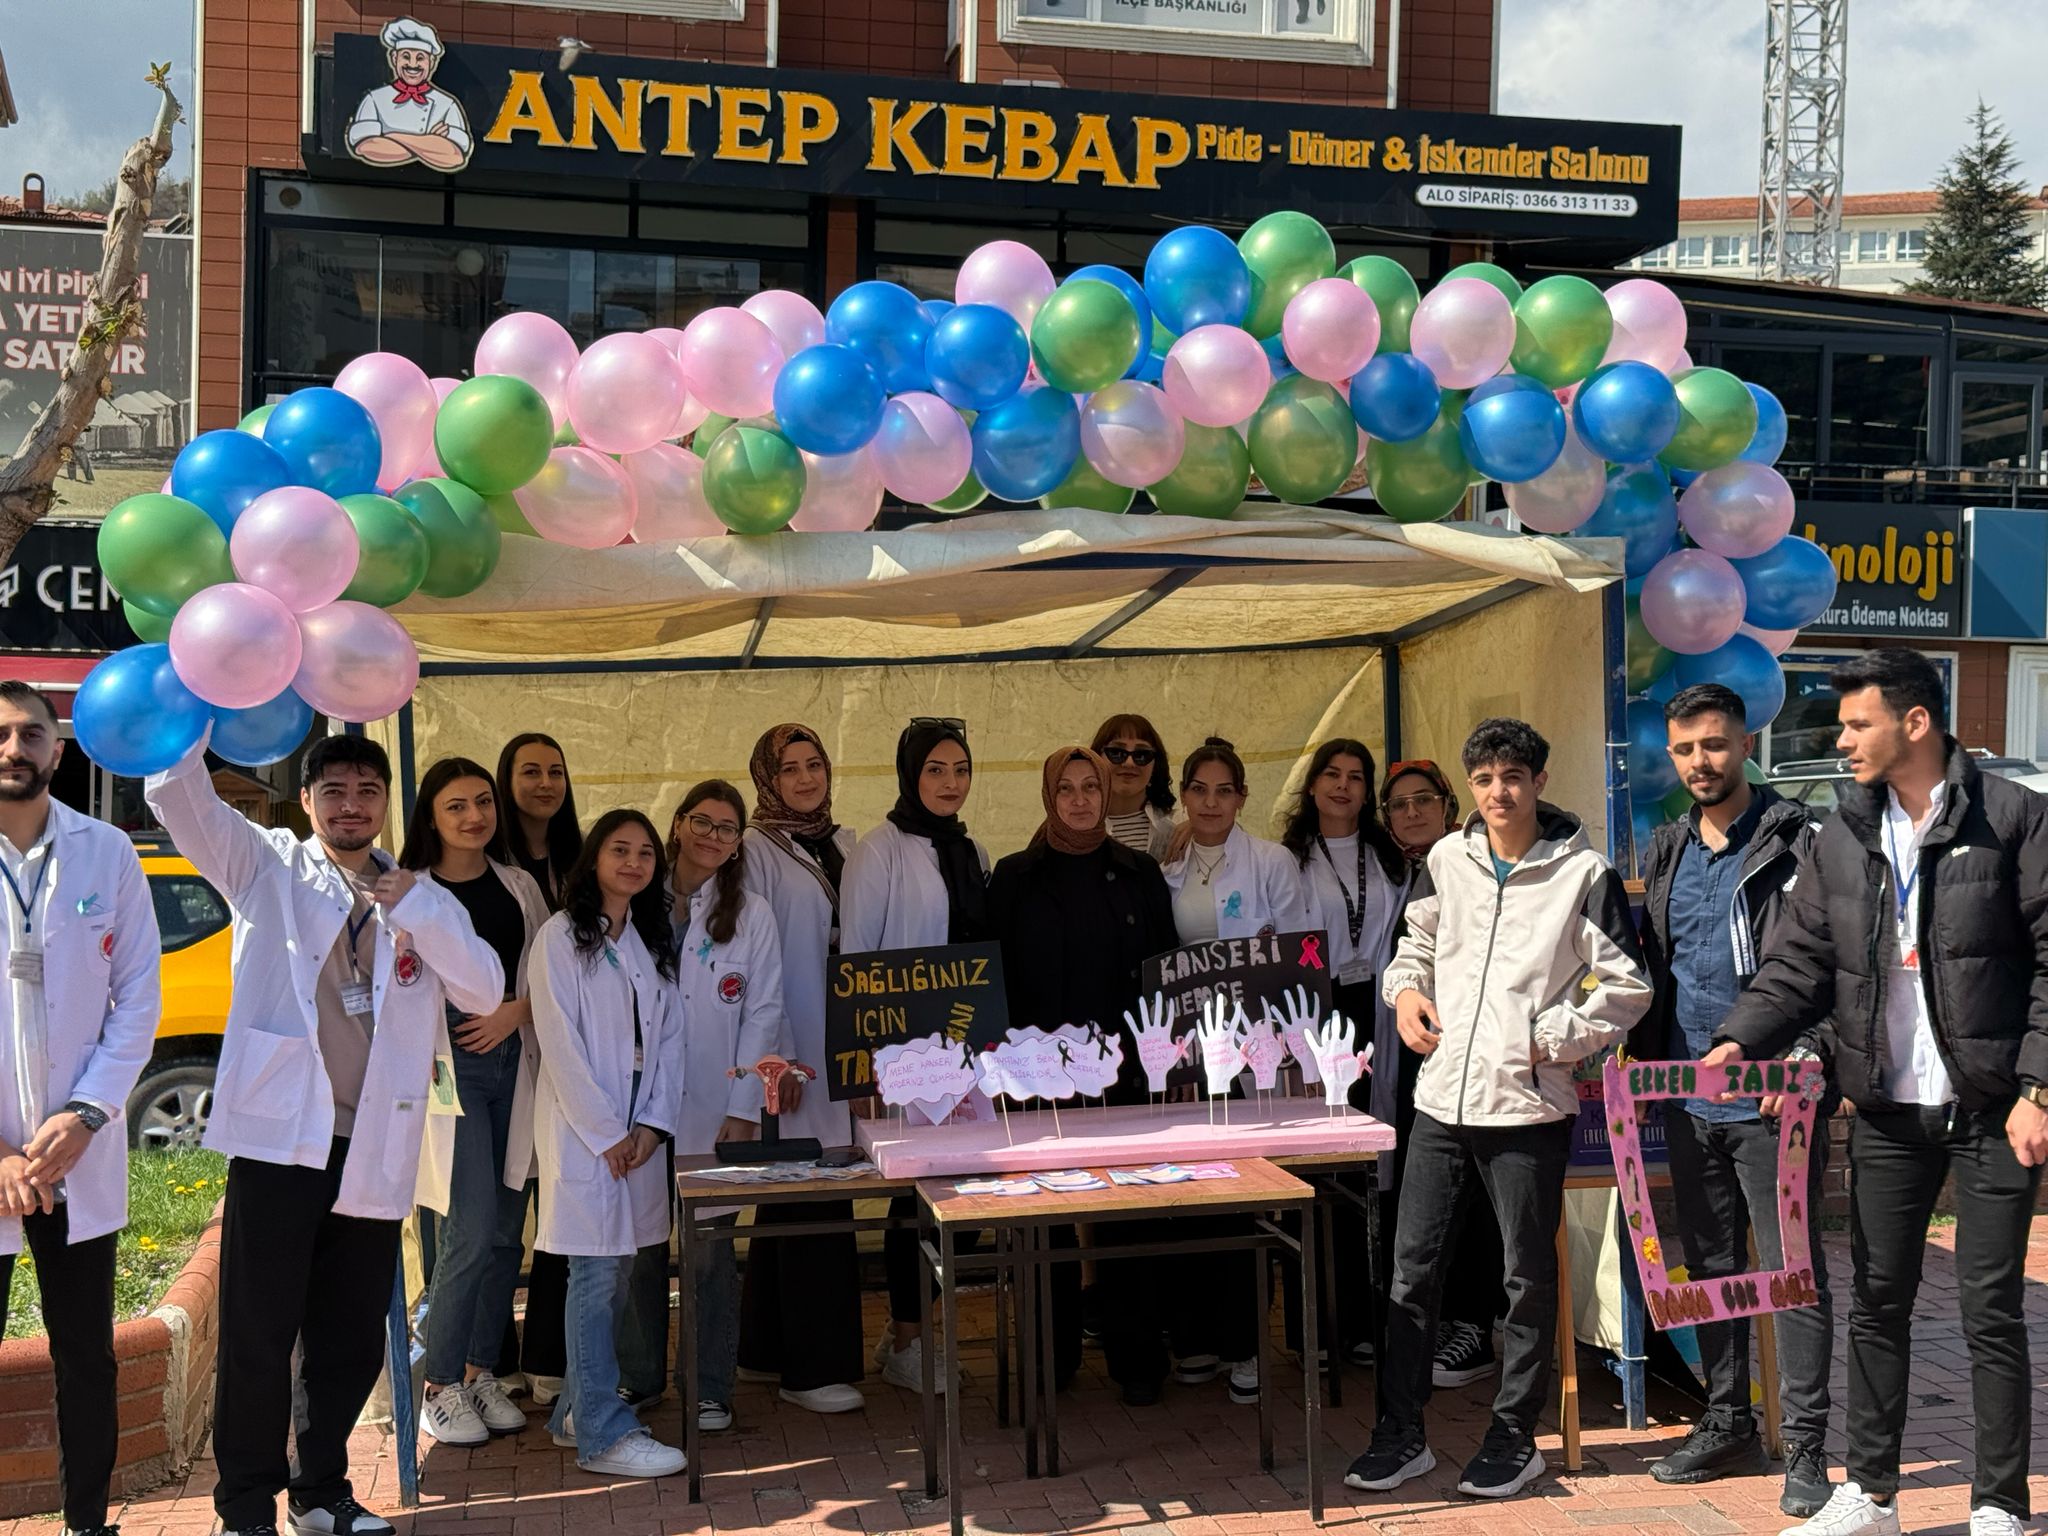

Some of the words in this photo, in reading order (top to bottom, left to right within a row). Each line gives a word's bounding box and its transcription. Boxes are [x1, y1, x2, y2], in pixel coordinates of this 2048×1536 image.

[1154, 0, 1247, 15] BAŞKANLIĞI
[484, 69, 840, 166] ANTEP
[866, 96, 1190, 190] KEBAP
[1196, 123, 1263, 163] Pide
[1288, 129, 1375, 169] Döner
[1382, 136, 1413, 172] &
[1417, 134, 1548, 179] İskender
[1550, 145, 1650, 184] Salonu
[1426, 188, 1455, 203] ALO
[1458, 185, 1519, 209] SİPARİŞ:
[1523, 193, 1558, 208] 0366
[1561, 196, 1588, 209] 313
[1592, 197, 1608, 211] 11
[1612, 199, 1630, 212] 33
[18, 267, 51, 294] İYİ
[1851, 600, 1897, 627] Ödeme
[1899, 606, 1949, 629] Noktası
[1160, 935, 1281, 986] KANSERİ
[834, 957, 990, 999] SAĞLIĞINIZ
[855, 1005, 907, 1041] İÇİN
[835, 1049, 871, 1087] TA
[1629, 1065, 1697, 1095] ERKEN
[1725, 1063, 1801, 1093] TANI
[1644, 1126, 1666, 1142] HAYA
